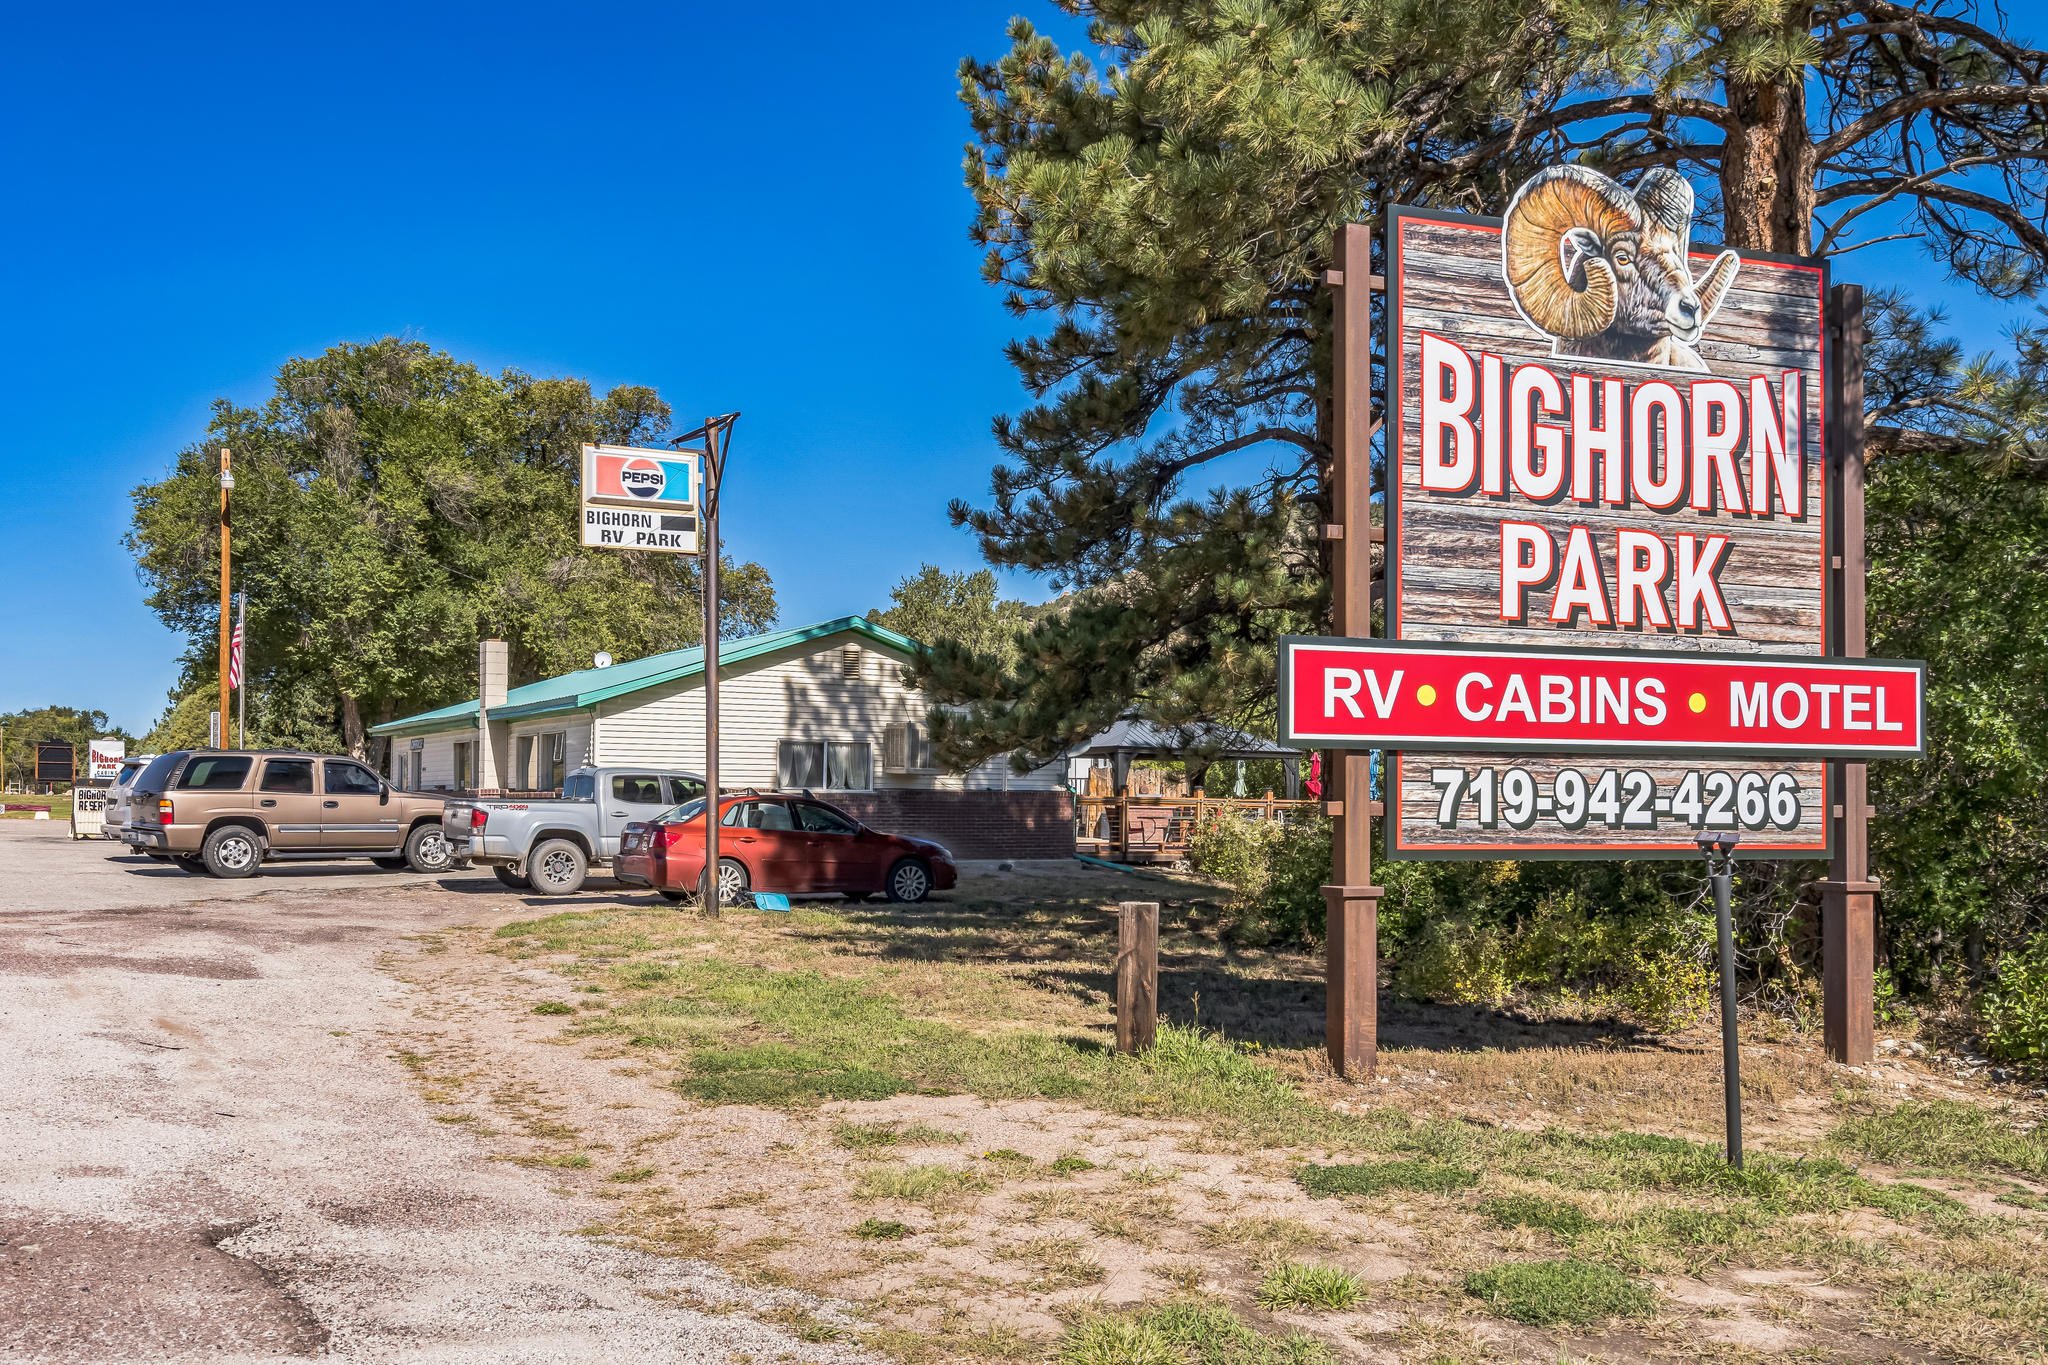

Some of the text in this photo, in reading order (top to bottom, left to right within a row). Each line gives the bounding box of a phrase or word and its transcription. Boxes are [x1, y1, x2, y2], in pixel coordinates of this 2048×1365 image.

[1420, 330, 1803, 518] BIGHORN
[622, 471, 663, 485] PEPSI
[586, 511, 652, 528] BIGHORN
[601, 530, 682, 547] RV PARK
[1500, 520, 1732, 631] PARK
[1323, 667, 1904, 732] RV CABINS MOTEL
[1432, 767, 1801, 830] 719-942-4266
